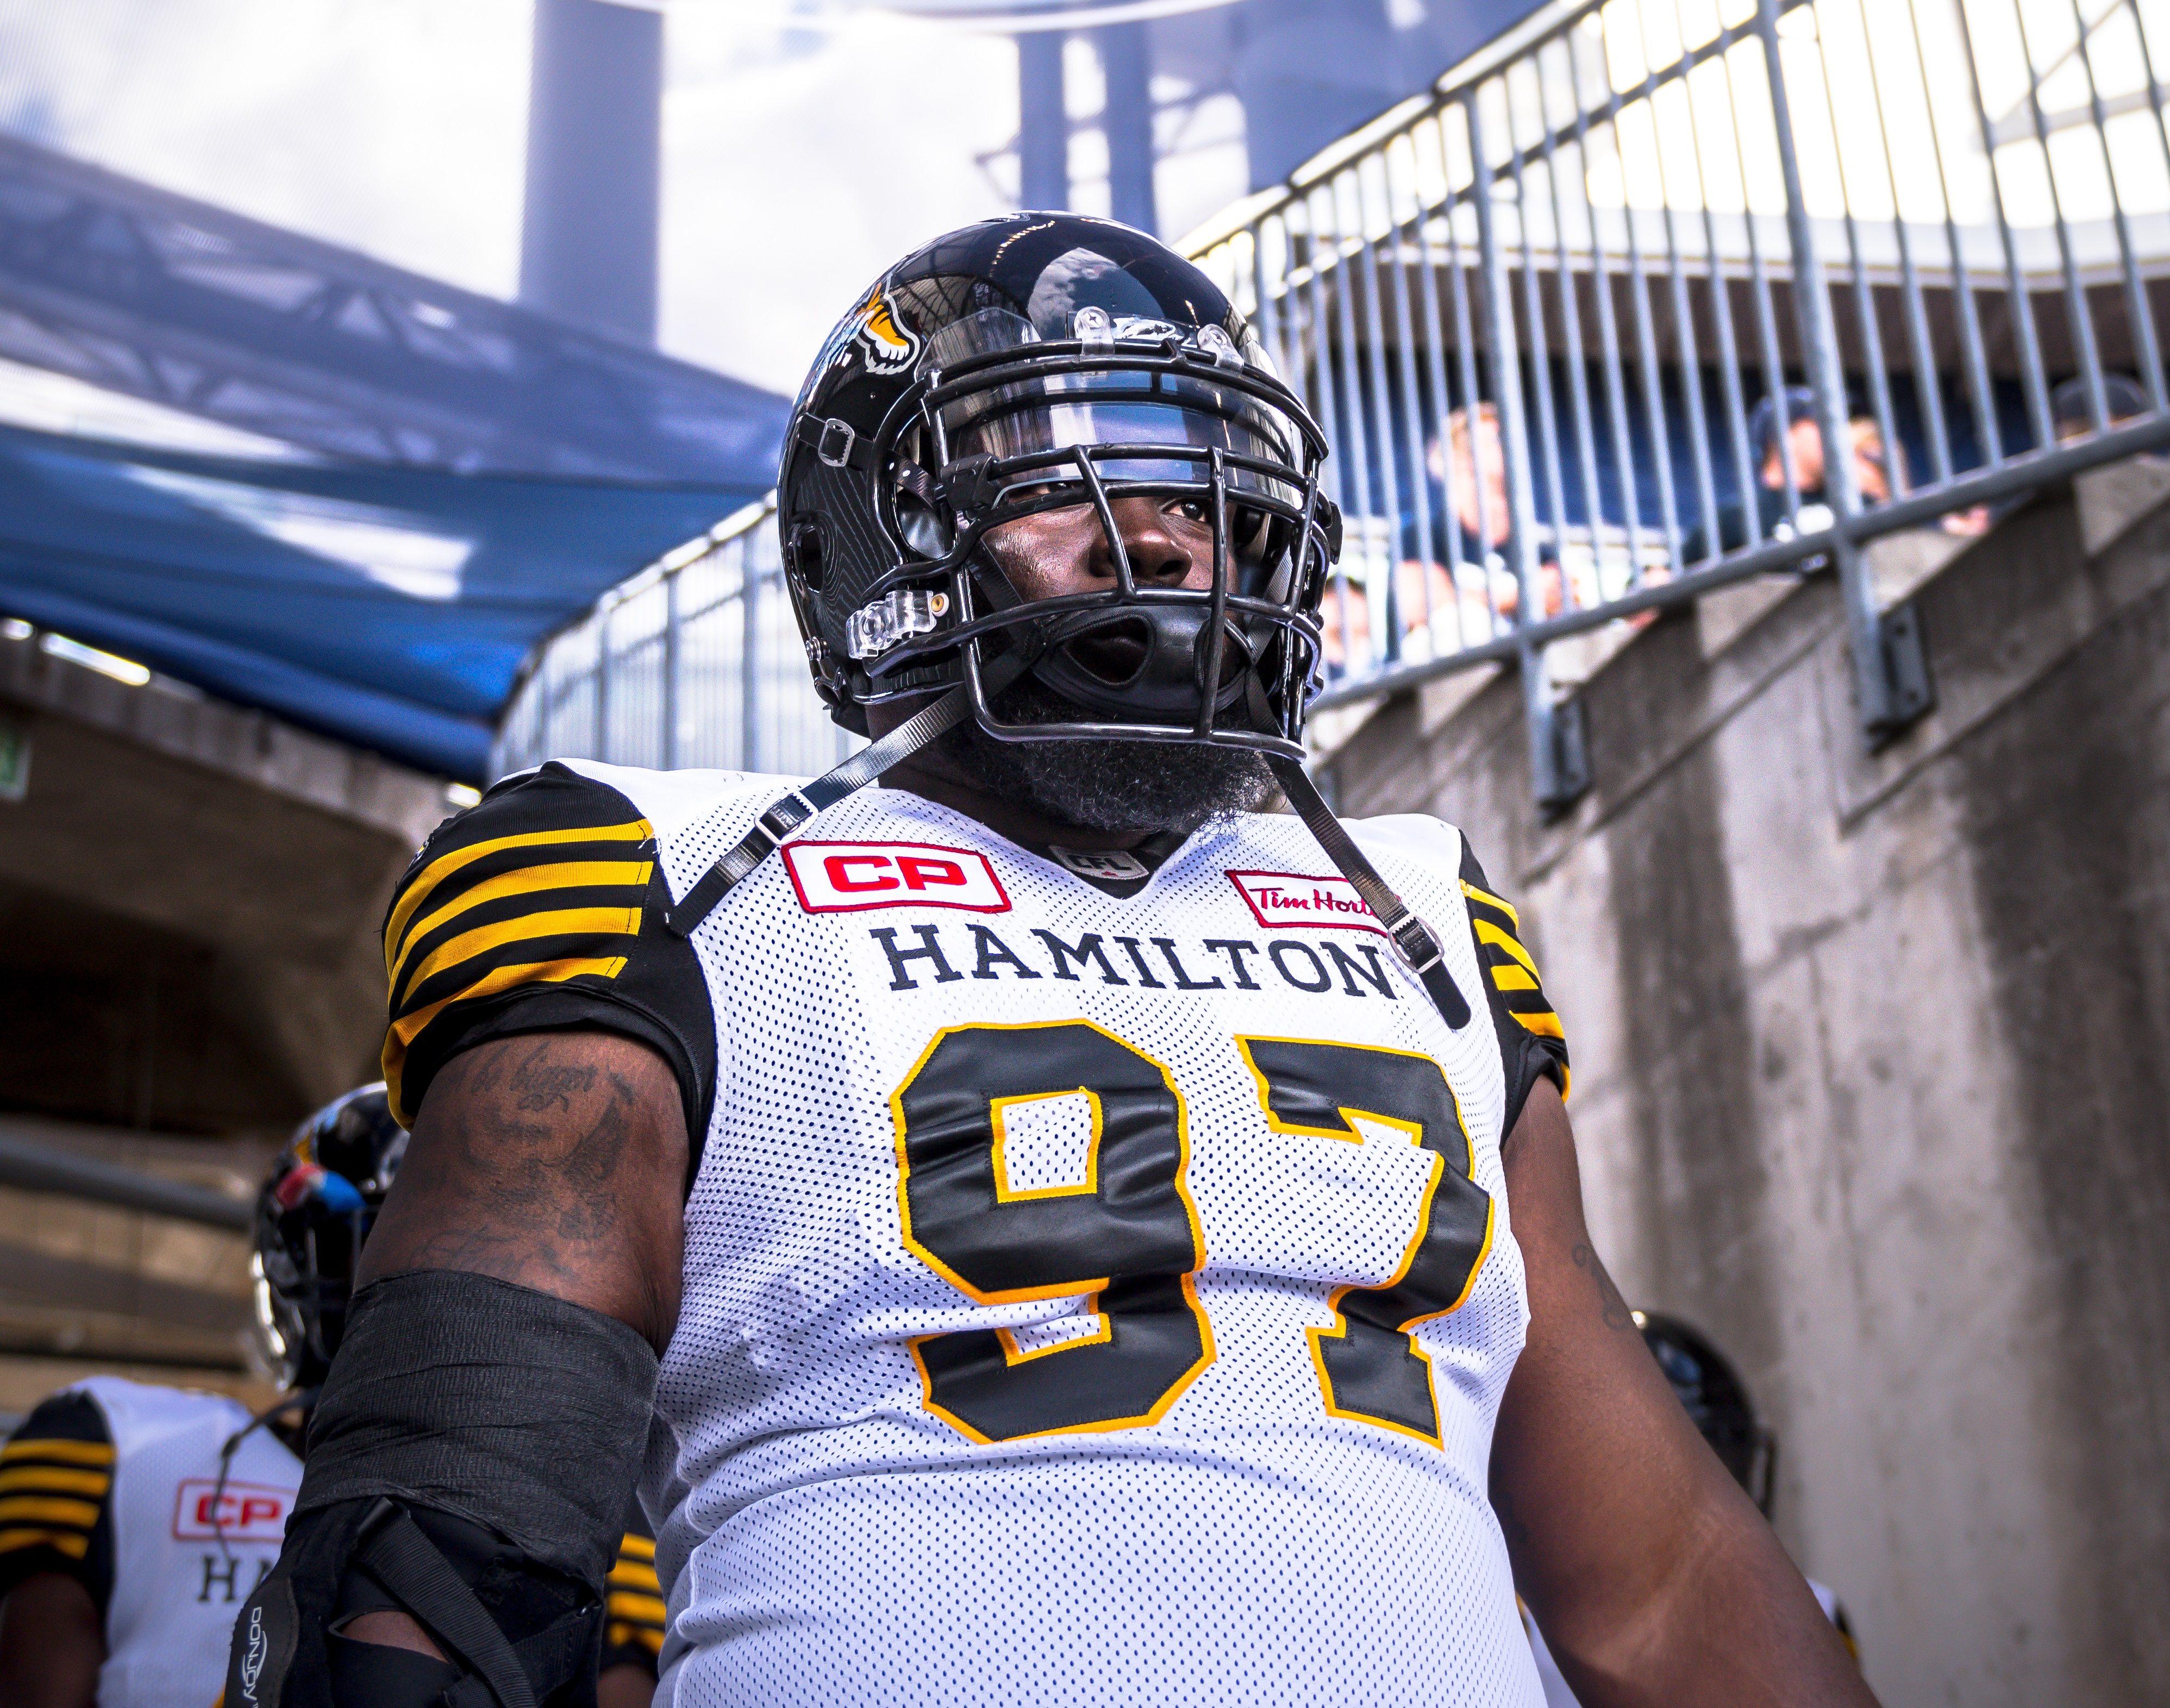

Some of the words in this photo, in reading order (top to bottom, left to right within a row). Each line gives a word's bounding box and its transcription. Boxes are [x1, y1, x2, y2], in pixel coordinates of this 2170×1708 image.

[823, 855, 967, 892] CP
[1066, 854, 1133, 871] CFL
[1248, 887, 1311, 910] Tim
[869, 924, 1398, 1000] HAMILTON
[889, 1018, 1494, 1452] 97
[196, 1494, 281, 1527] CP
[244, 1606, 262, 1700] DONJOY
